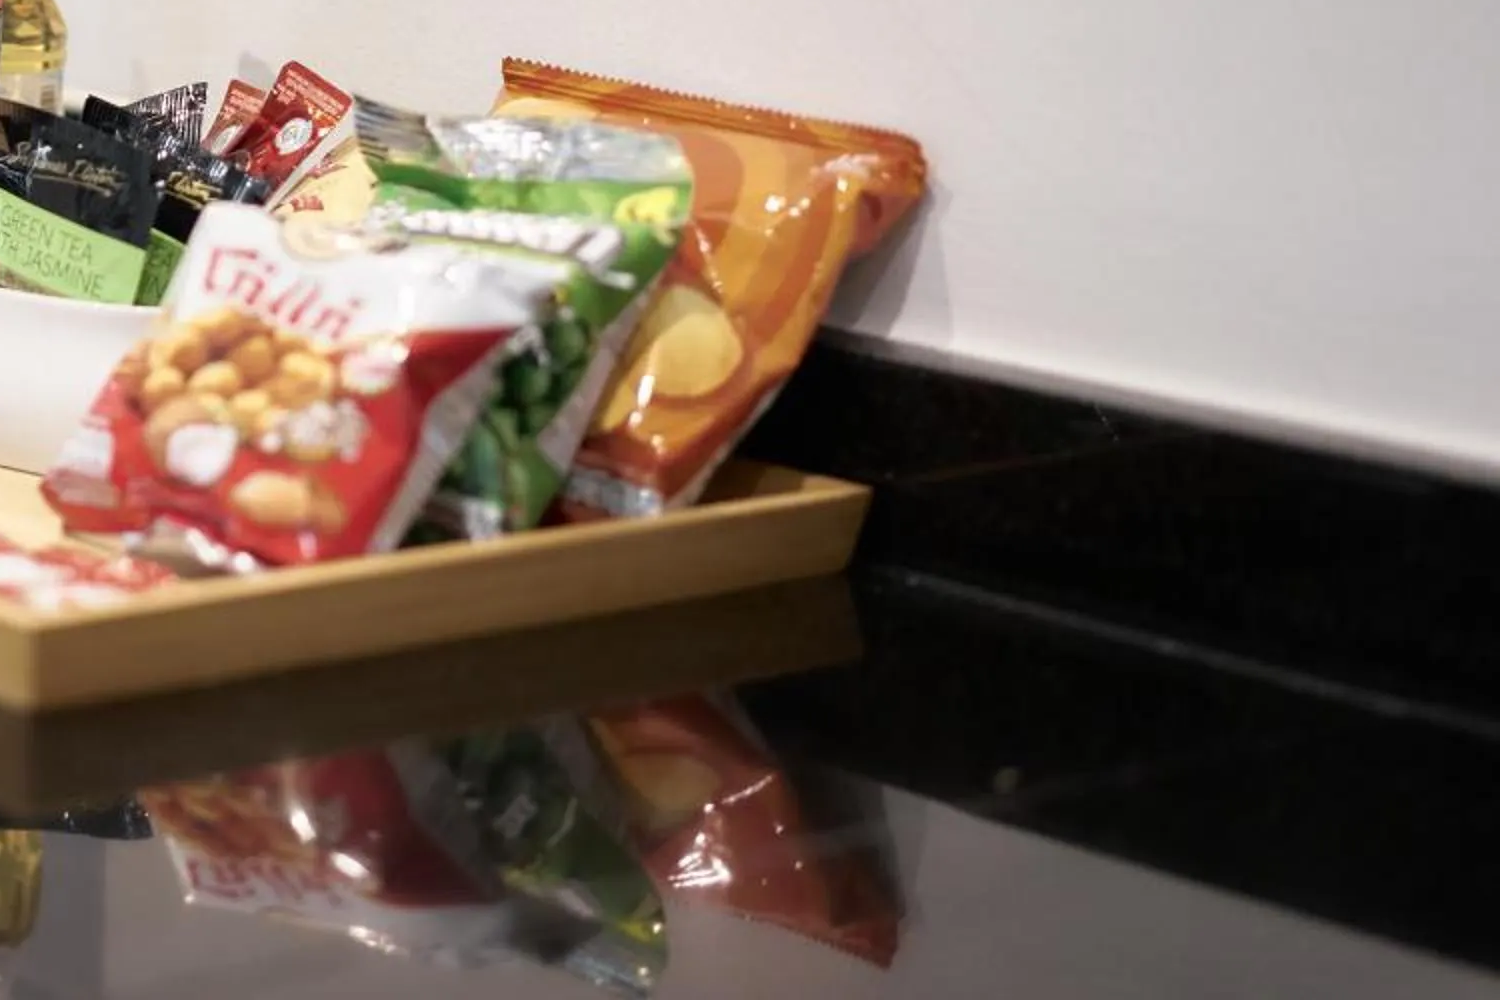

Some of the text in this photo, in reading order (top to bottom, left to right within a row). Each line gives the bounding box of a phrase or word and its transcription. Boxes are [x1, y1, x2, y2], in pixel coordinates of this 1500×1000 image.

[0, 203, 52, 247] GREEN
[58, 229, 93, 265] TEA
[22, 246, 105, 300] JASMINE
